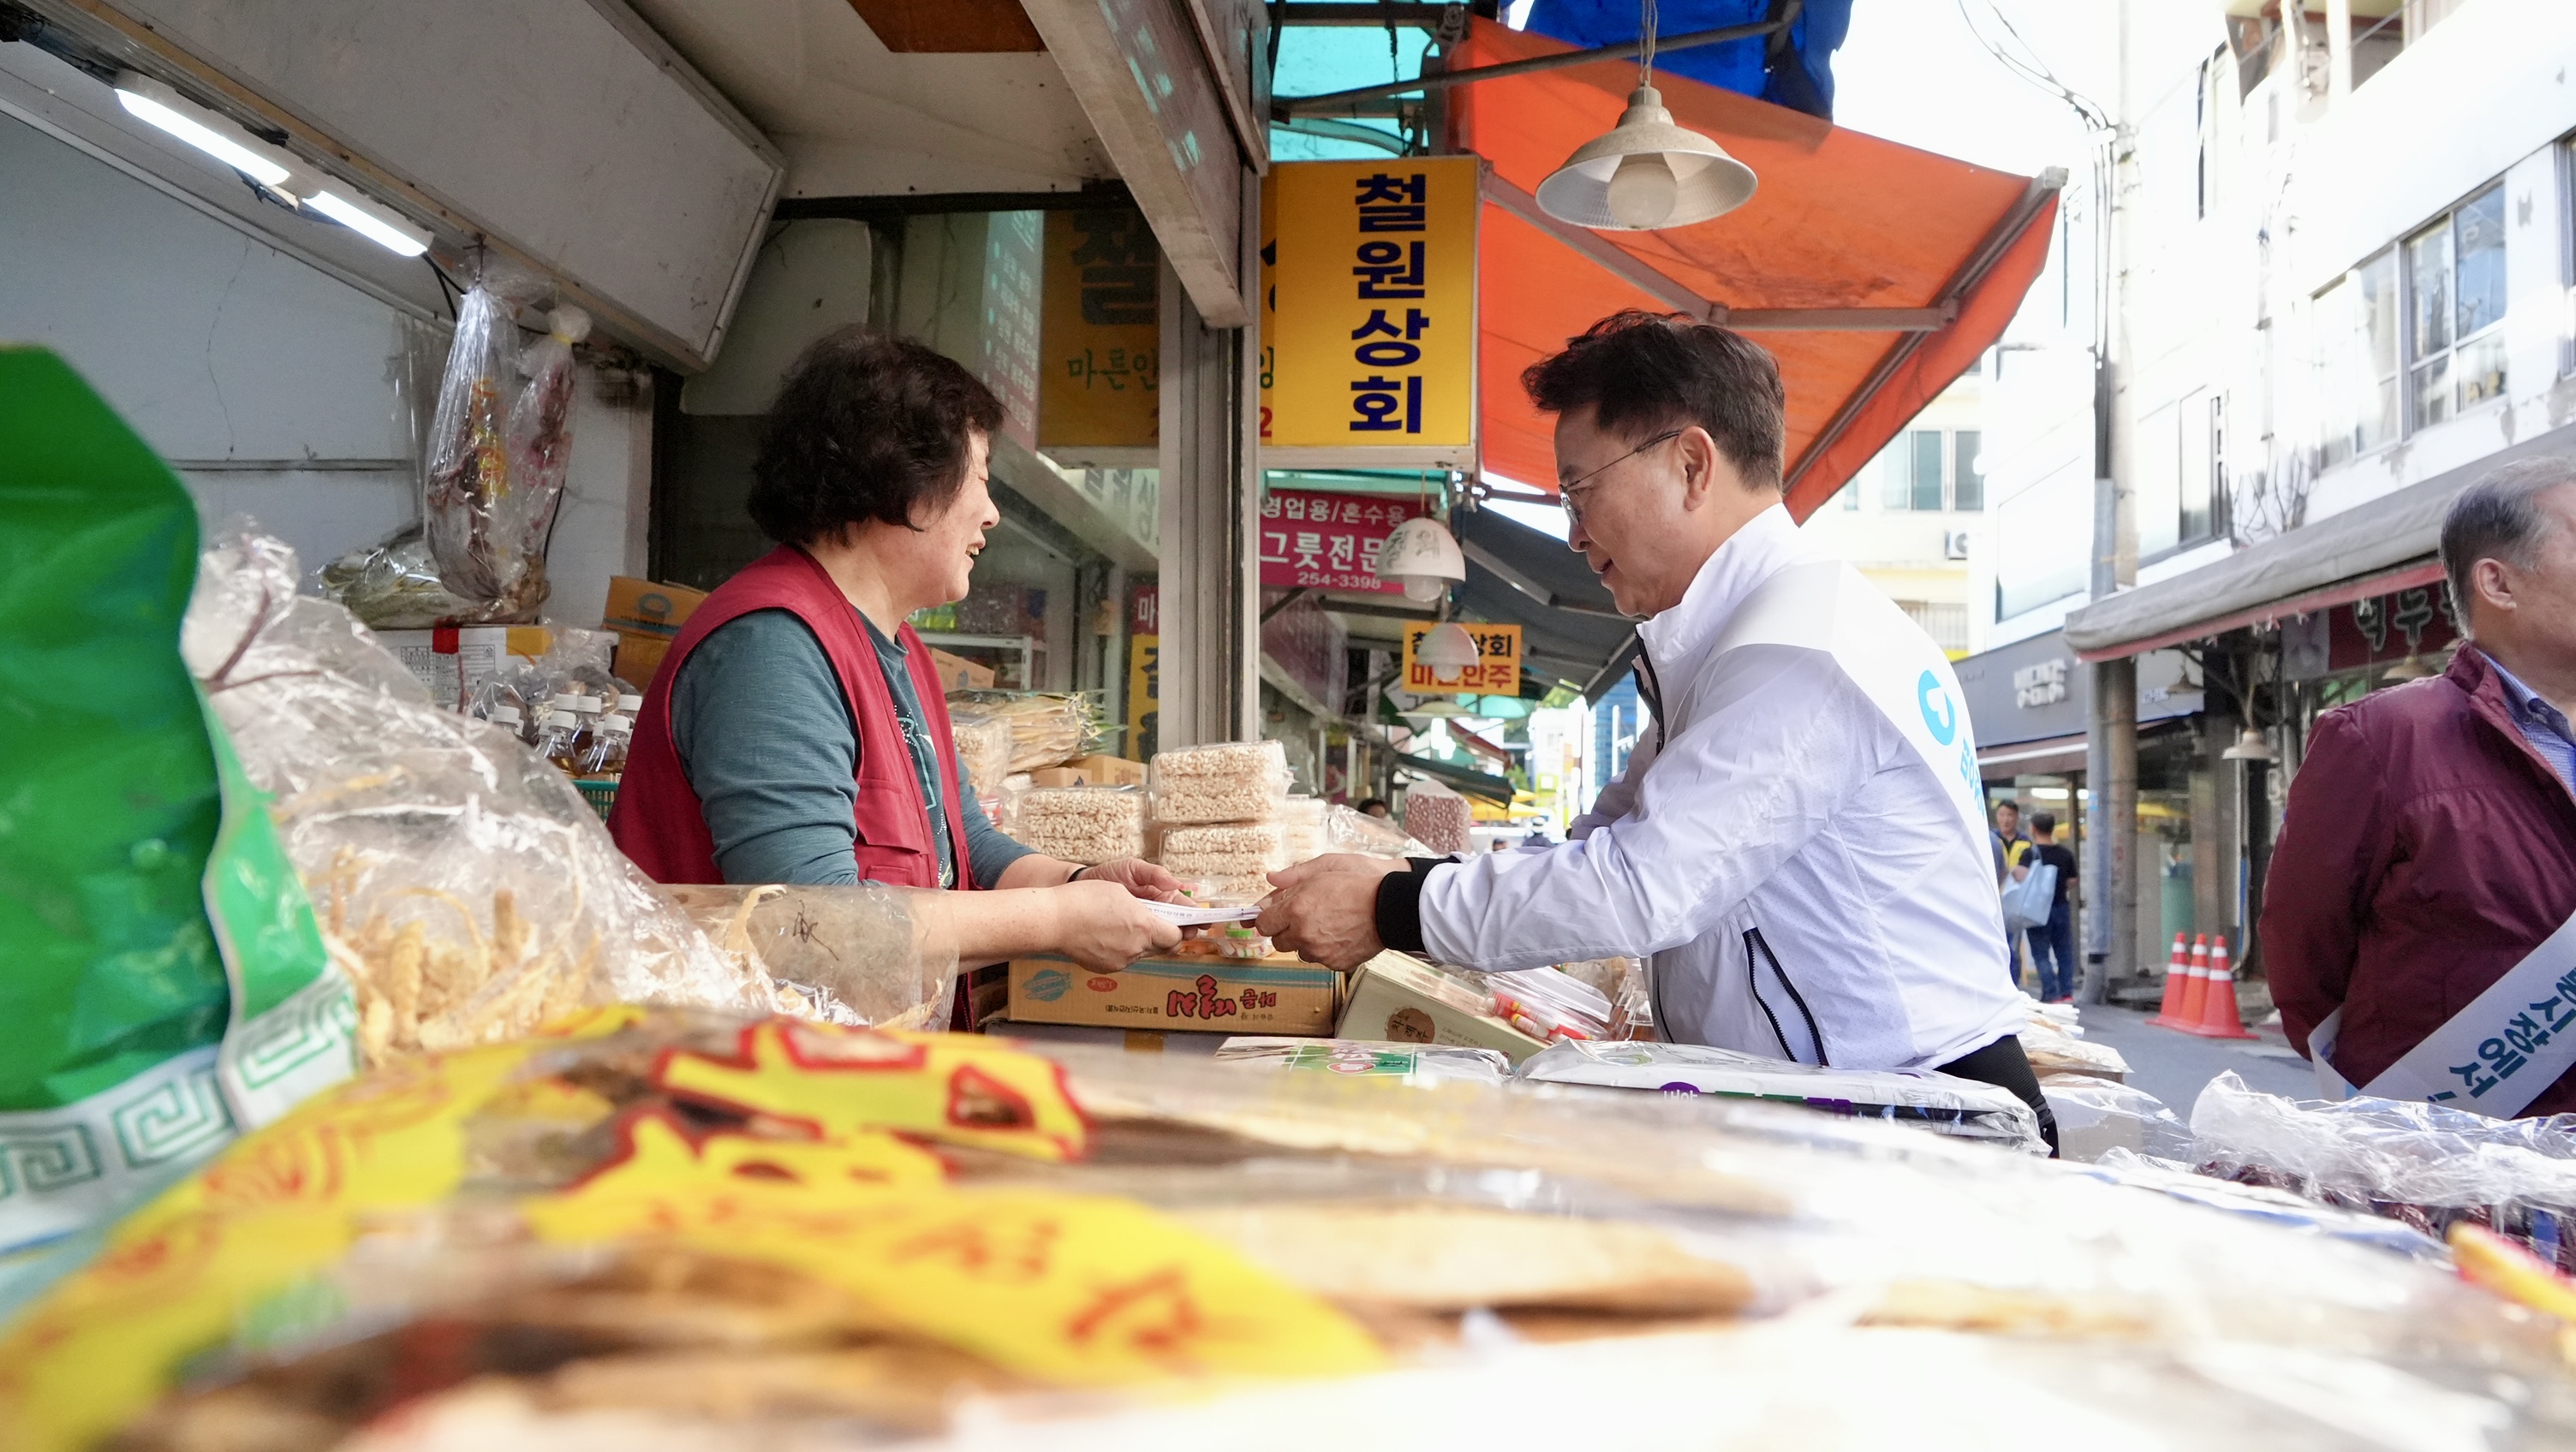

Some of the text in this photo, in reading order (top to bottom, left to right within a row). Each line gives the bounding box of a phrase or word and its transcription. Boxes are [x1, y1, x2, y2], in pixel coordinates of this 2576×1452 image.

[1350, 174, 1430, 434] 철원상회
[1166, 973, 1277, 1021] 마른 멸치
